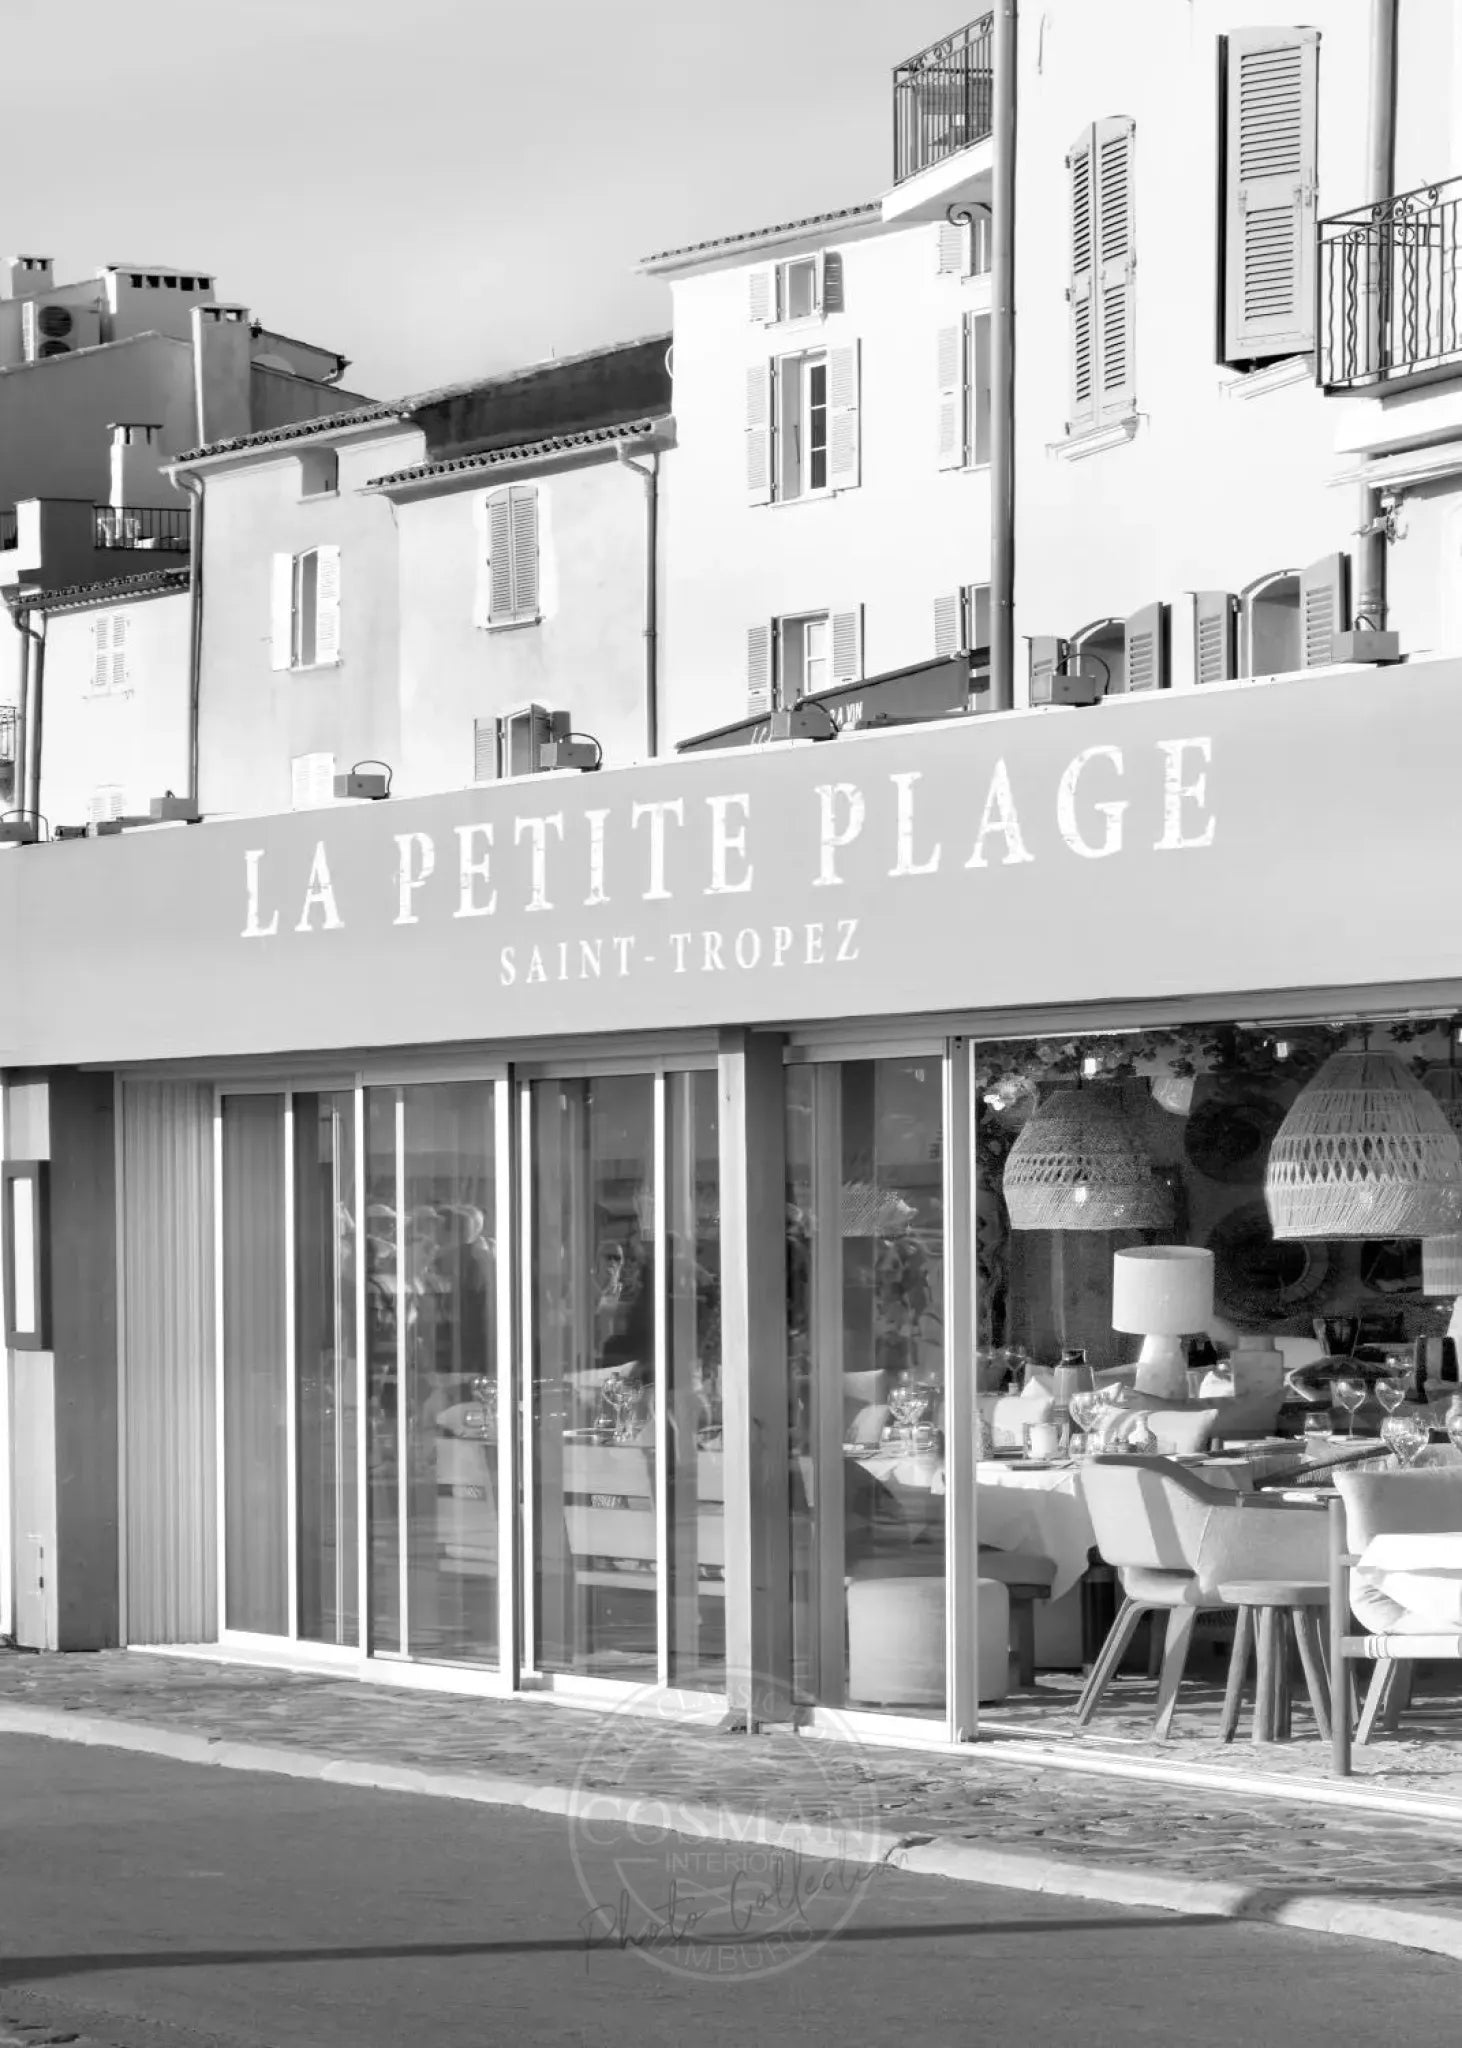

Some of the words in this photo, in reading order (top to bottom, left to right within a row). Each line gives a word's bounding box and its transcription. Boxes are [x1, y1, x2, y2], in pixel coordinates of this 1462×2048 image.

[241, 840, 345, 937] LA
[393, 793, 754, 926] PETITE
[811, 736, 1216, 886] PLAGE
[500, 918, 861, 986] SAINT-TROPEZ
